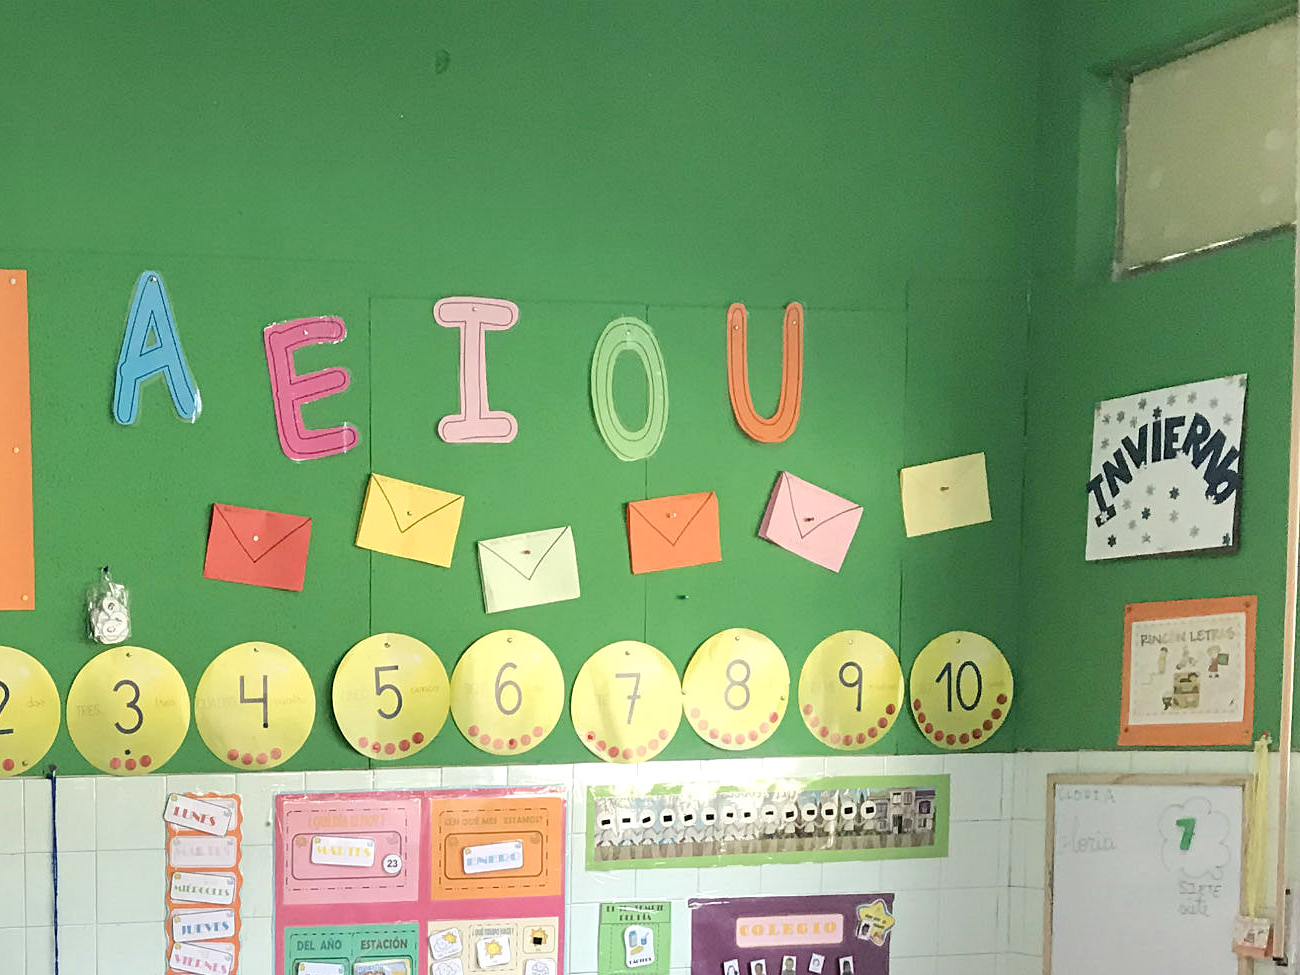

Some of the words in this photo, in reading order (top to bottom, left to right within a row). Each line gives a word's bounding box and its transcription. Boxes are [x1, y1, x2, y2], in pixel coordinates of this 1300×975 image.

[112, 269, 202, 425] A
[263, 315, 359, 461] E
[433, 295, 520, 444] I
[590, 315, 670, 462] O
[726, 300, 804, 445] U
[1086, 412, 1241, 527] INVIERNO
[113, 679, 144, 735] 3
[239, 674, 269, 728] 4
[374, 665, 403, 719] 5
[494, 662, 522, 715] 6
[615, 672, 641, 725] 7
[724, 659, 751, 711] 8
[838, 661, 863, 712] 9
[935, 660, 982, 712] 10
[1175, 818, 1196, 850] 7
[386, 859, 398, 868] 23
[297, 940, 315, 951] DEL
[320, 938, 342, 950] AÑO
[360, 936, 408, 950] ESTACIÓN
[739, 921, 838, 937] COLEGIO
